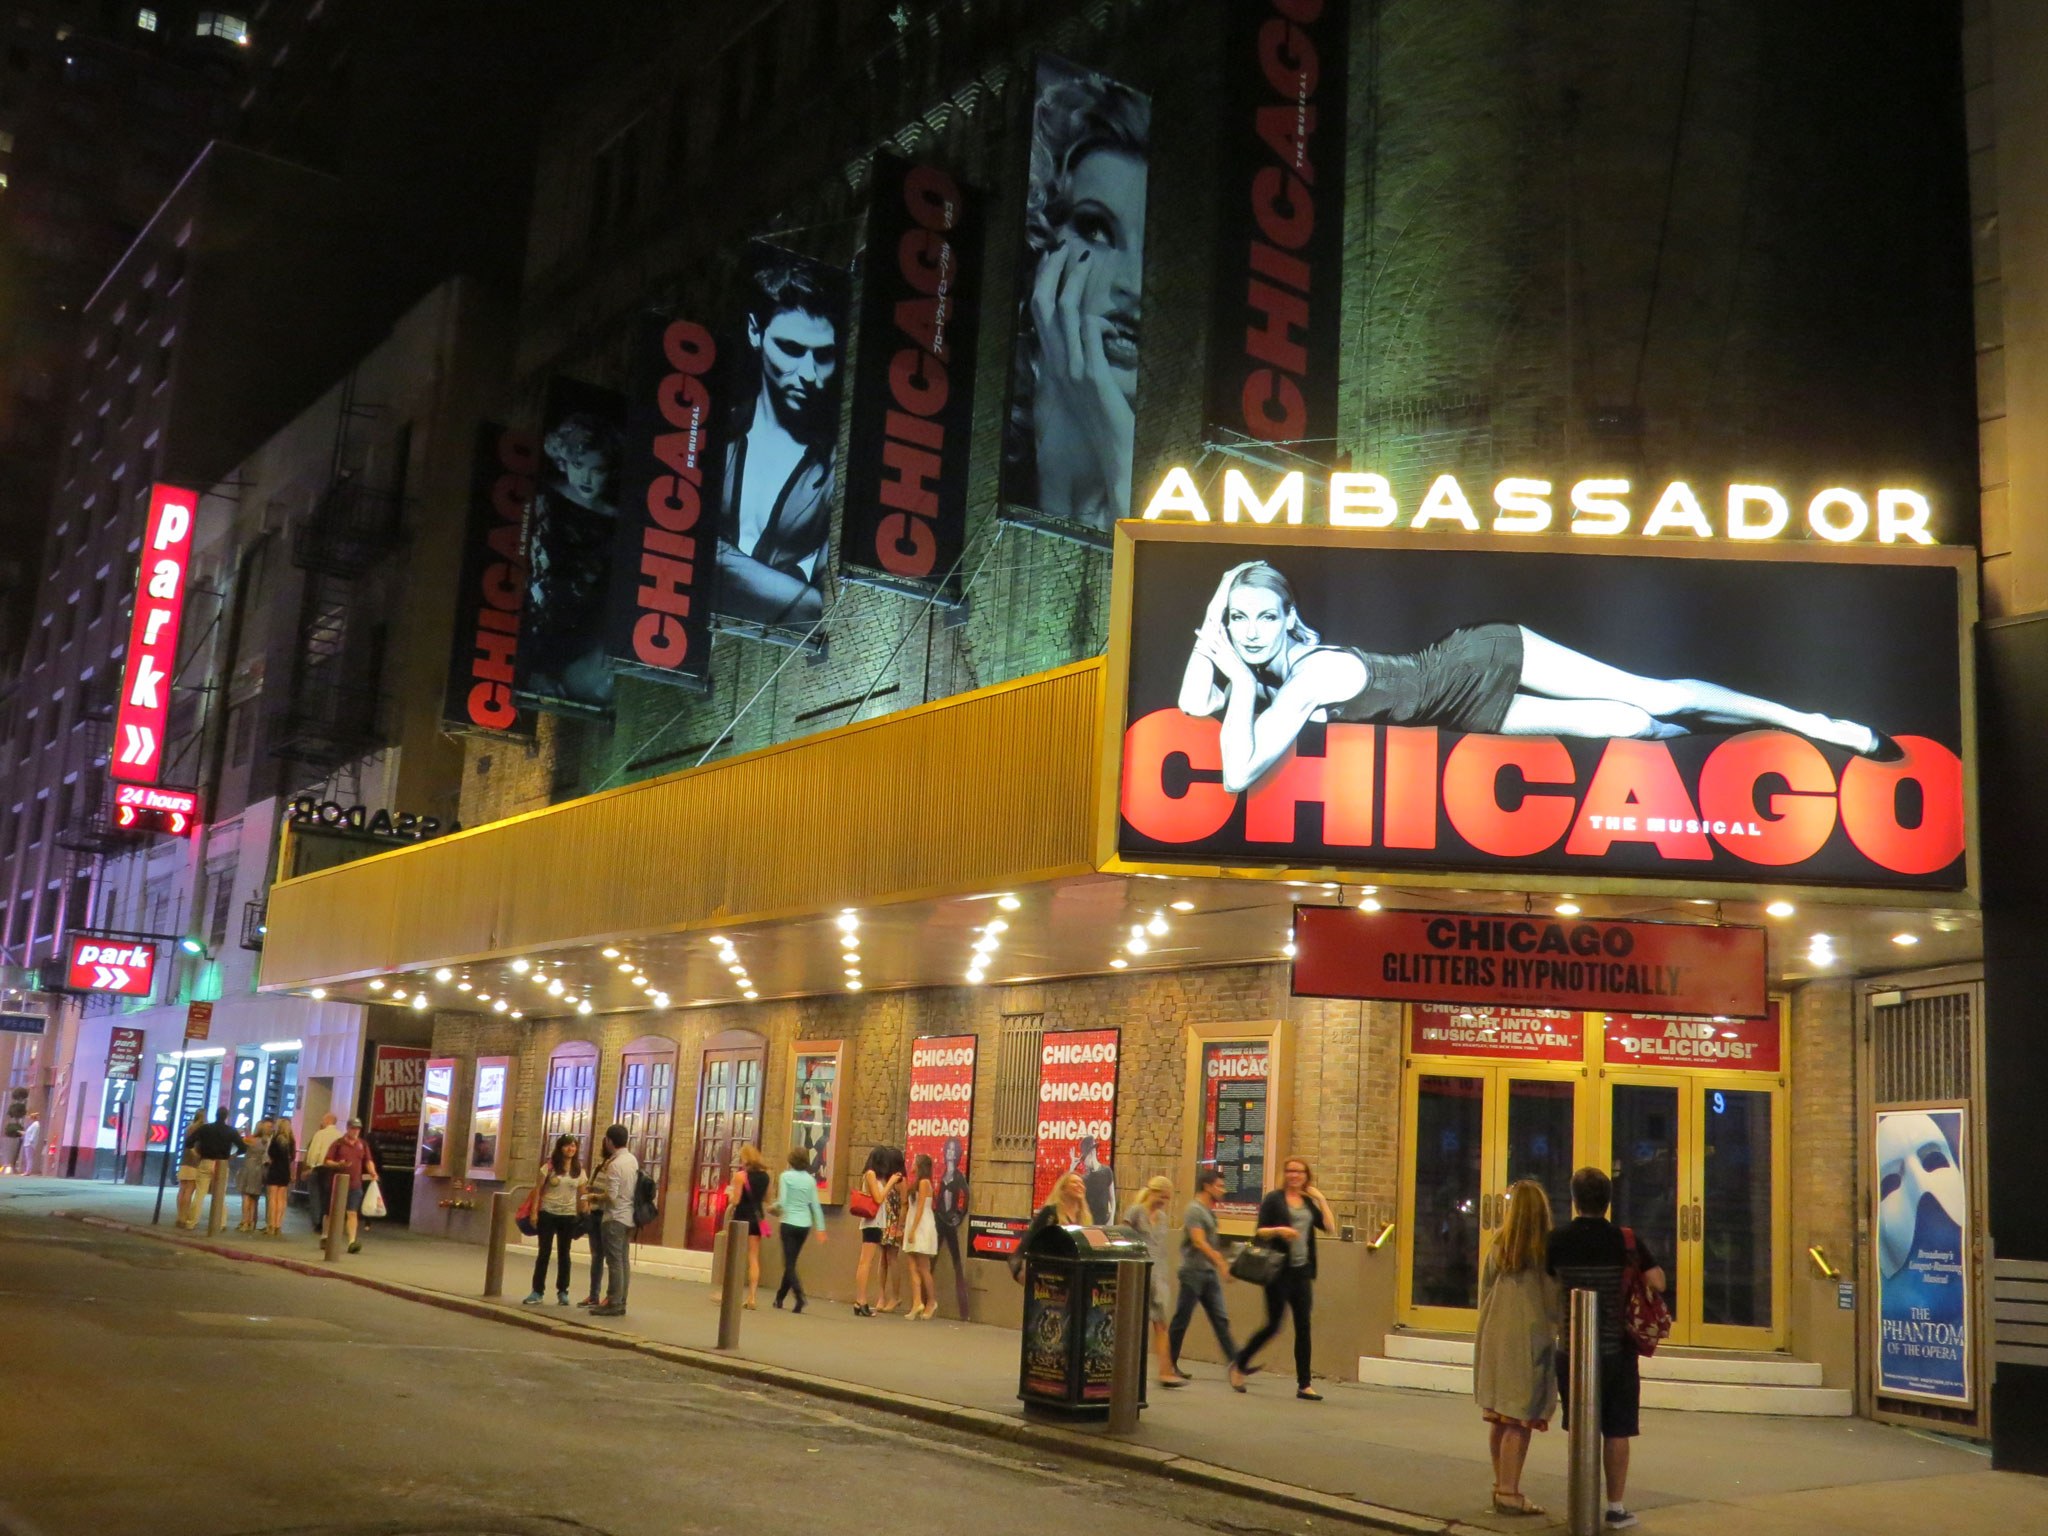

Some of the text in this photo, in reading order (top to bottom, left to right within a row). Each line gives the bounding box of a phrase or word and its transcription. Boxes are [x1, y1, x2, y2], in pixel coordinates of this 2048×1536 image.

[1296, 72, 1307, 168] THE MUSICAL
[875, 164, 962, 578] CHICAGO
[687, 406, 700, 469] DE MUSICAL
[633, 319, 717, 669] CHICAGO
[1142, 467, 1941, 545] AMBASSADOR
[520, 502, 531, 542] MUSICAL
[467, 431, 541, 730] CHICAGO
[129, 503, 190, 709] park
[119, 787, 192, 812] 24 hours
[1120, 708, 1965, 874] CHICAGO
[1590, 816, 1761, 836] THE MUSICAL
[77, 945, 150, 968] park
[1383, 952, 1496, 987] GLITTERS
[1423, 1028, 1499, 1044] MUSICAL
[1450, 1016, 1542, 1032] RIGHT INTO
[1664, 1022, 1715, 1040] AND
[912, 1047, 974, 1067] CHICAGO
[1042, 1043, 1117, 1064] CHICAGO
[375, 1058, 428, 1086] JERSE
[152, 1066, 176, 1122] park
[384, 1086, 424, 1114] BOYS
[910, 1083, 972, 1102] CHICAGO
[1040, 1081, 1114, 1102] CHICAGO
[1712, 1092, 1725, 1114] 9
[908, 1119, 970, 1137] CHICAGO
[1038, 1120, 1112, 1141] CHICAGO
[1911, 1307, 1931, 1320] THE
[1882, 1318, 1964, 1347] PHANTOM
[1887, 1341, 1958, 1361] OF THE OPERA
